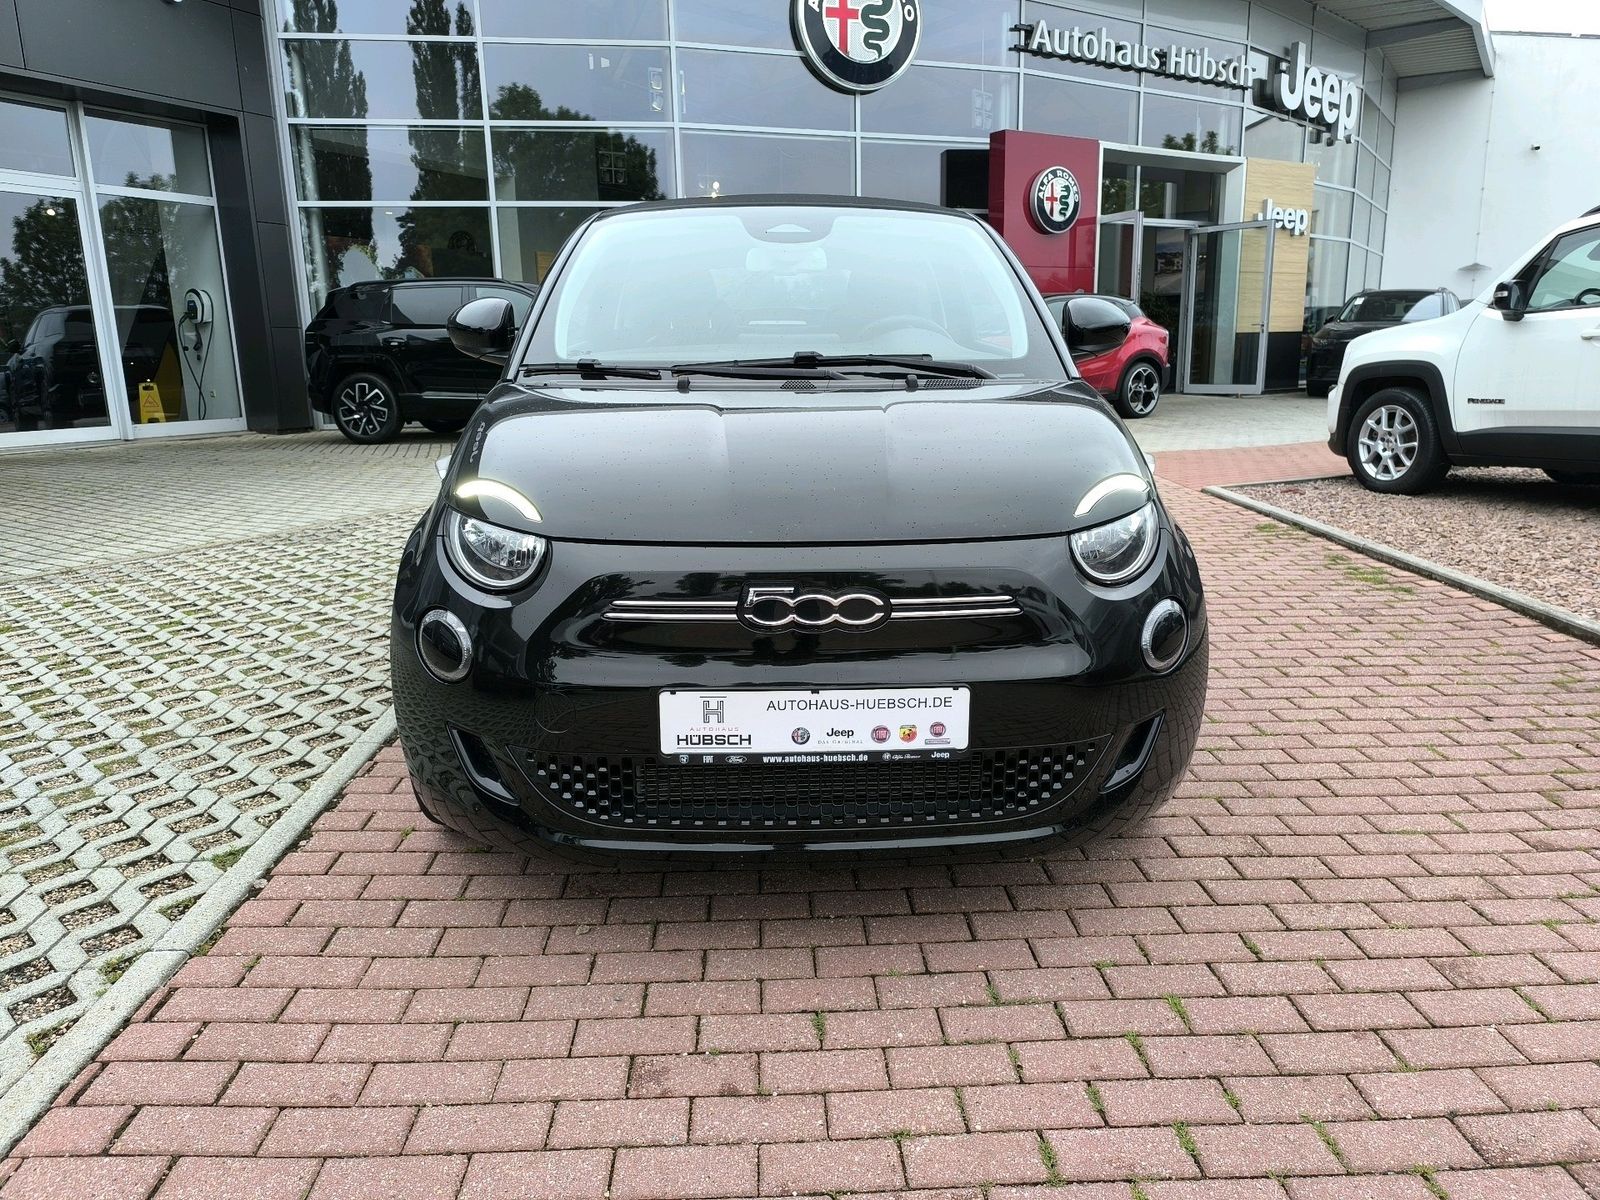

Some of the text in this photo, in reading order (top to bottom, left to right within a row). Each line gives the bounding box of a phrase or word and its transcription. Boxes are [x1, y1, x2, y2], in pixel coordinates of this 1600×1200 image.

[1030, 19, 1253, 87] Autohaus Hübsch
[1274, 41, 1359, 141] Jeep
[1038, 170, 1079, 202] ALFA ROMEO
[1257, 198, 1308, 236] Jeep
[744, 587, 884, 626] 500
[766, 697, 953, 711] AUTOHAUS-HUEBSCH.DE
[676, 734, 752, 746] HÜBSCH
[826, 727, 855, 738] Jeep
[762, 753, 869, 764] www.autohaus-huebsch.de
[930, 750, 950, 759] Jeep
